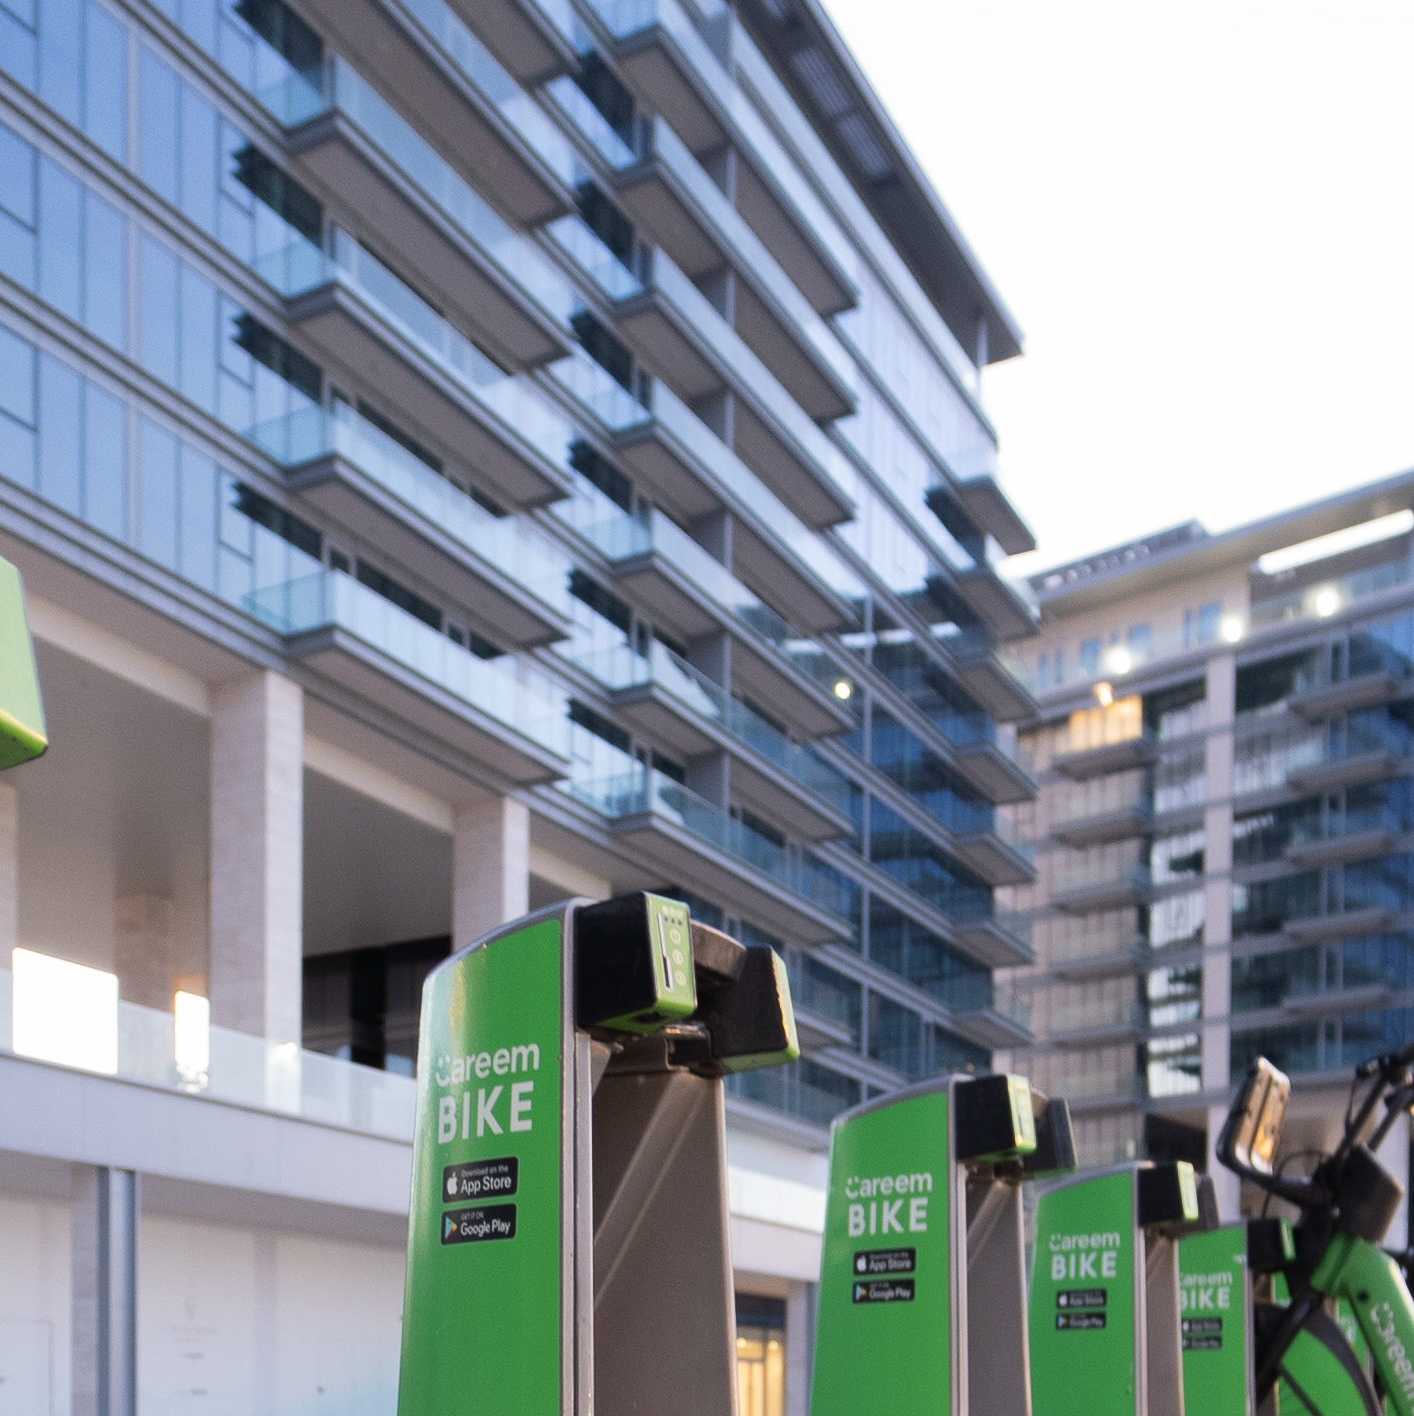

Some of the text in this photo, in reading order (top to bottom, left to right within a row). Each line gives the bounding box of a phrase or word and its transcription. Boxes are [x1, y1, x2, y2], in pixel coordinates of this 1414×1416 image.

[435, 1043, 540, 1087] Careem
[438, 1081, 535, 1145] BIKE
[460, 1175, 512, 1196] App Store
[845, 1172, 933, 1199] Careem
[460, 1218, 511, 1238] Google Play
[848, 1197, 929, 1238] BIKE
[1049, 1231, 1121, 1252] Careem
[1051, 1250, 1118, 1282] BIKE
